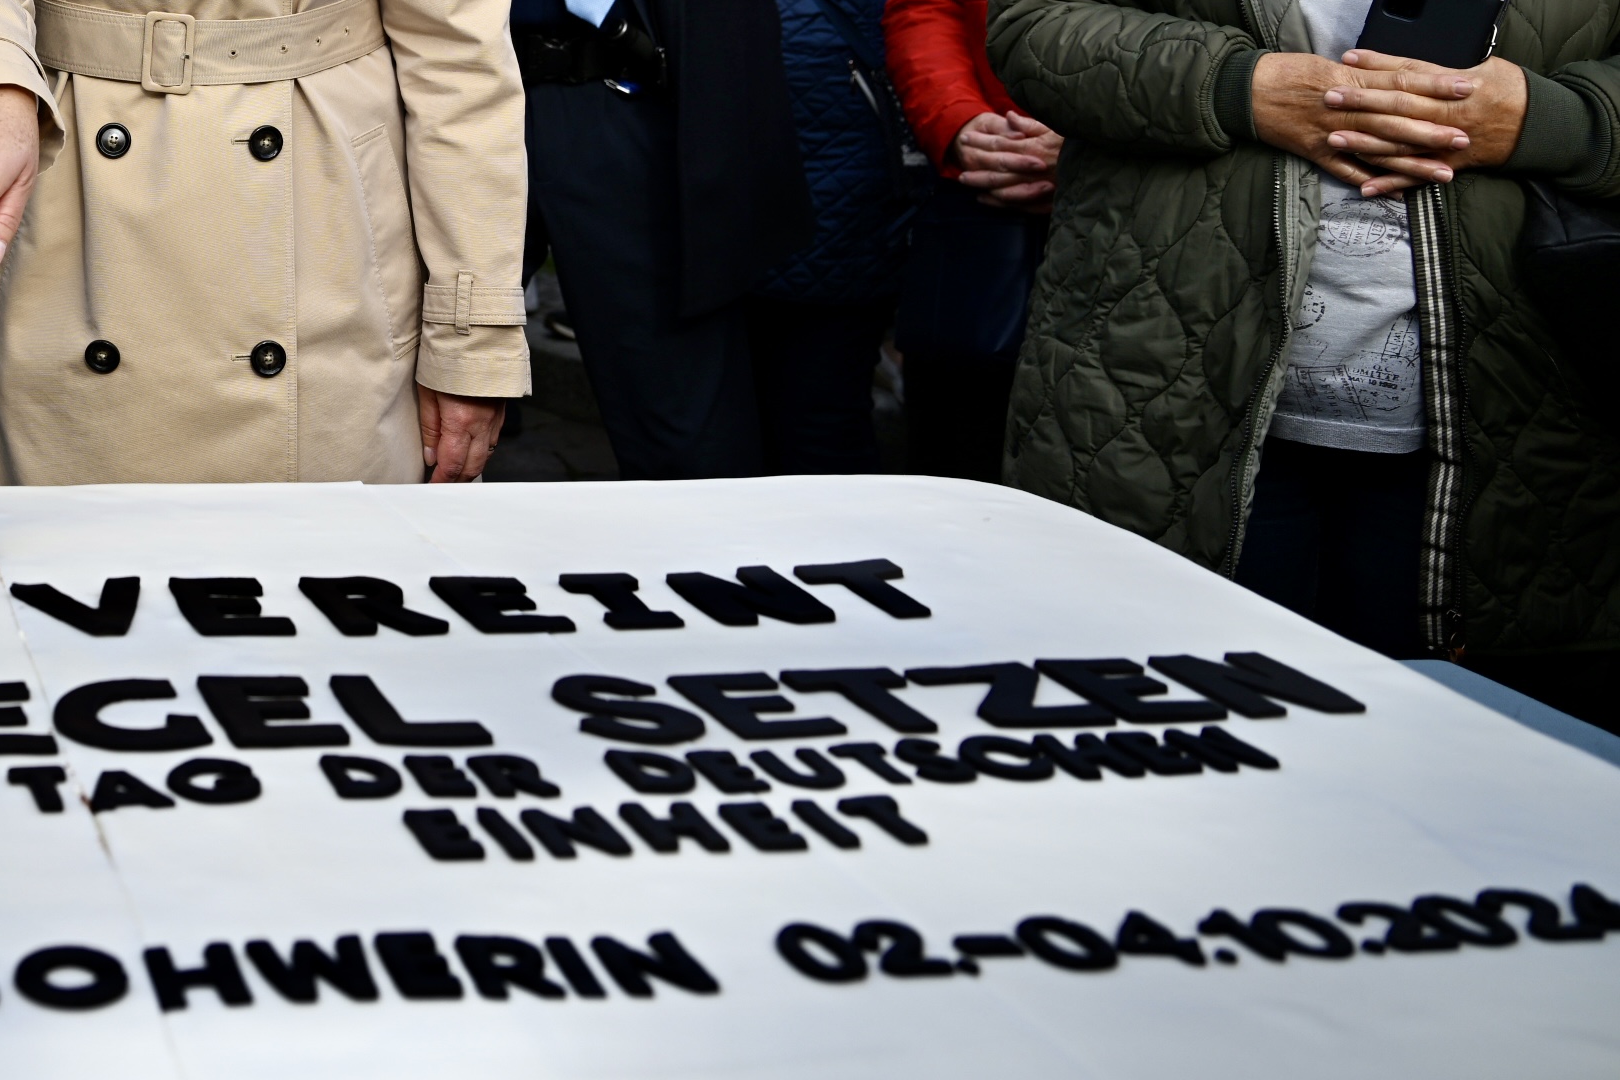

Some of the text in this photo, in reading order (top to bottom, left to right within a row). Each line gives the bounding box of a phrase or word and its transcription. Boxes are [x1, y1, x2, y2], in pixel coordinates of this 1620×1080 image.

[9, 558, 932, 638] VEREINT
[550, 651, 1367, 746] SETZEN
[7, 757, 262, 815] TAG
[319, 754, 561, 800] DER
[402, 795, 929, 862] EINHEIT
